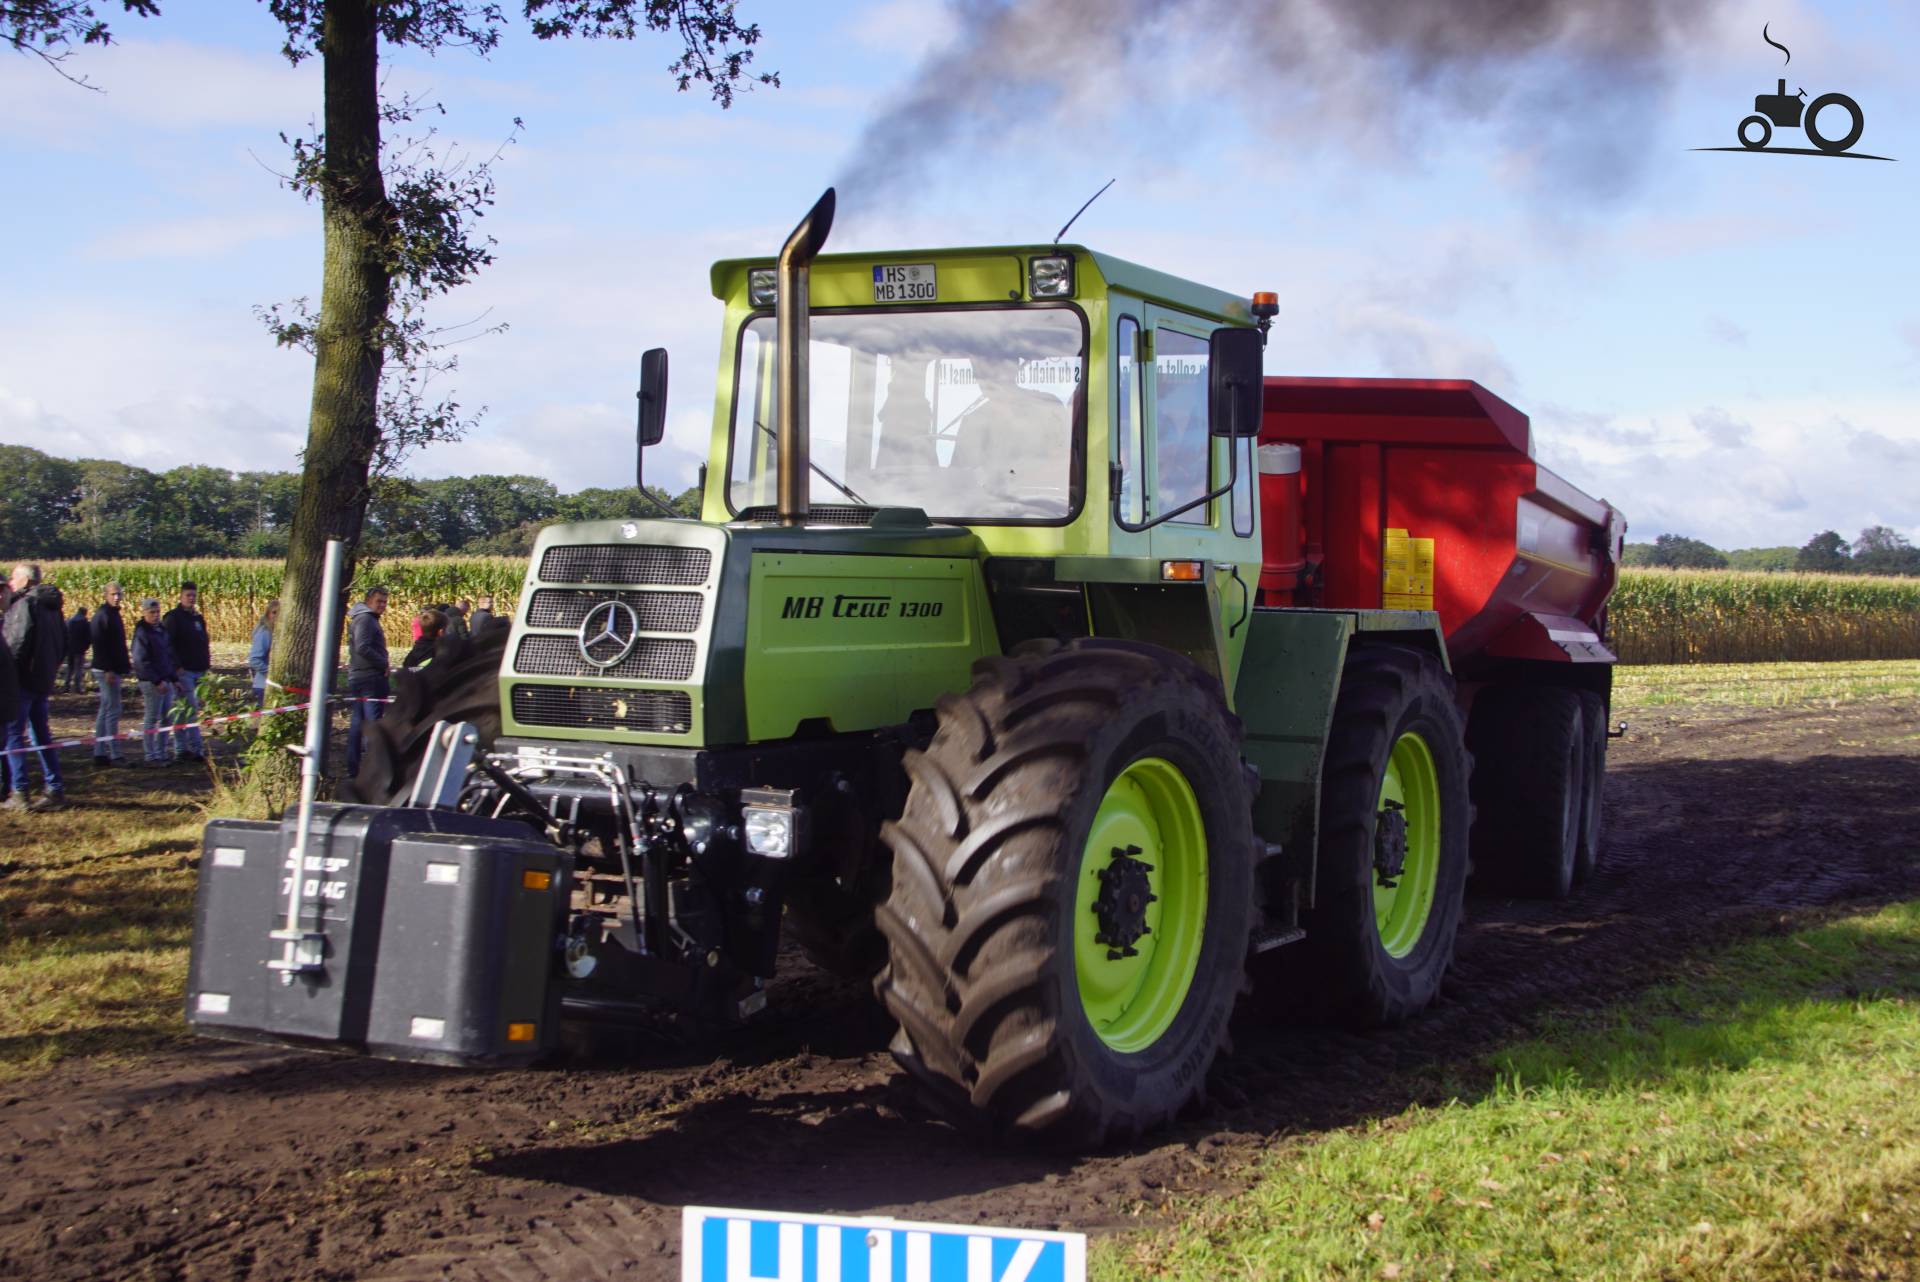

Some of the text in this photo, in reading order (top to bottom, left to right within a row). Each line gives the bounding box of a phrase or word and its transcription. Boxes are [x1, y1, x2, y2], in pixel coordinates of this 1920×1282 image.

[886, 267, 906, 282] HS
[876, 282, 935, 300] MB 1300
[781, 596, 825, 619] MB
[899, 602, 943, 618] 1300
